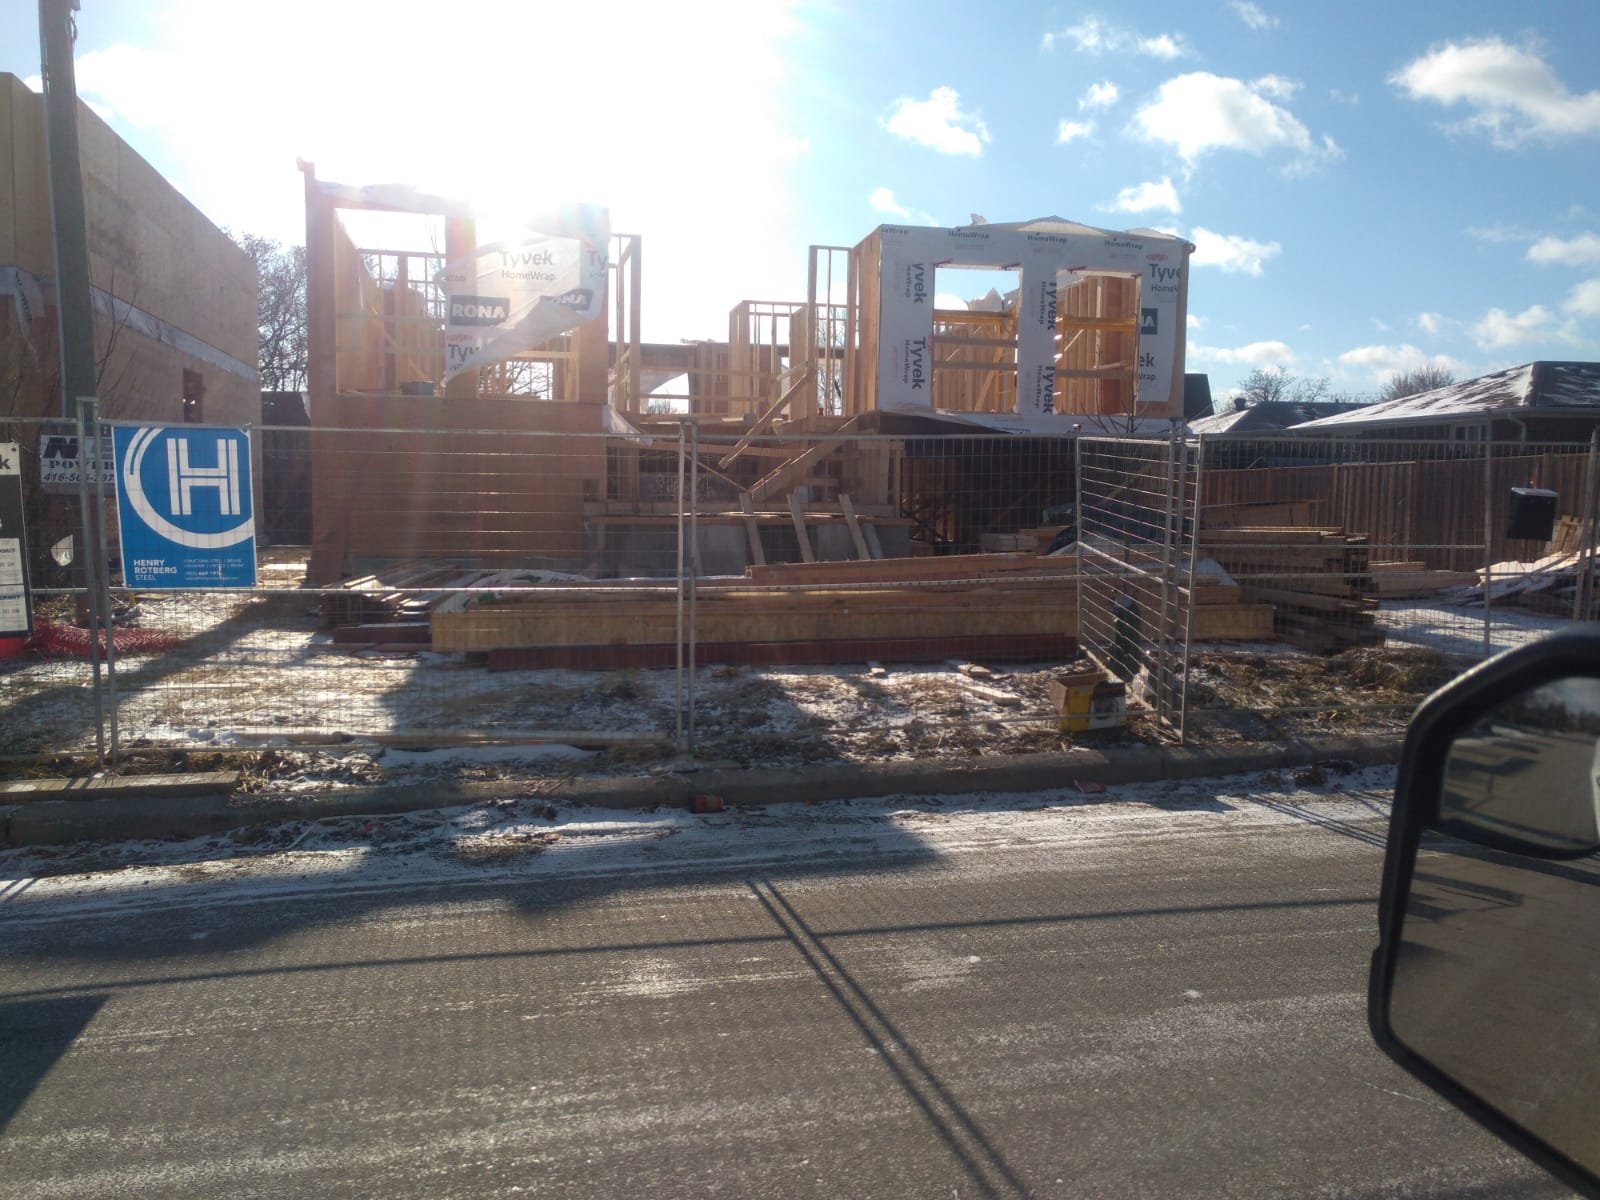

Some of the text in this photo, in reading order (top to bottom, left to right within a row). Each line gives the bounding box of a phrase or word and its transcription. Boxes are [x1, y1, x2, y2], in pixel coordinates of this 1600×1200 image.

[501, 249, 553, 268] Tyvek
[502, 270, 556, 281] HomeWrap
[451, 303, 506, 319] RONA
[902, 339, 911, 384] HomeWrap
[912, 336, 926, 390] Tyvek
[1034, 364, 1043, 408] HomeWrap
[1043, 365, 1056, 414] Tyvek
[134, 559, 165, 567] HENRY
[134, 566, 178, 574] ROTBERG
